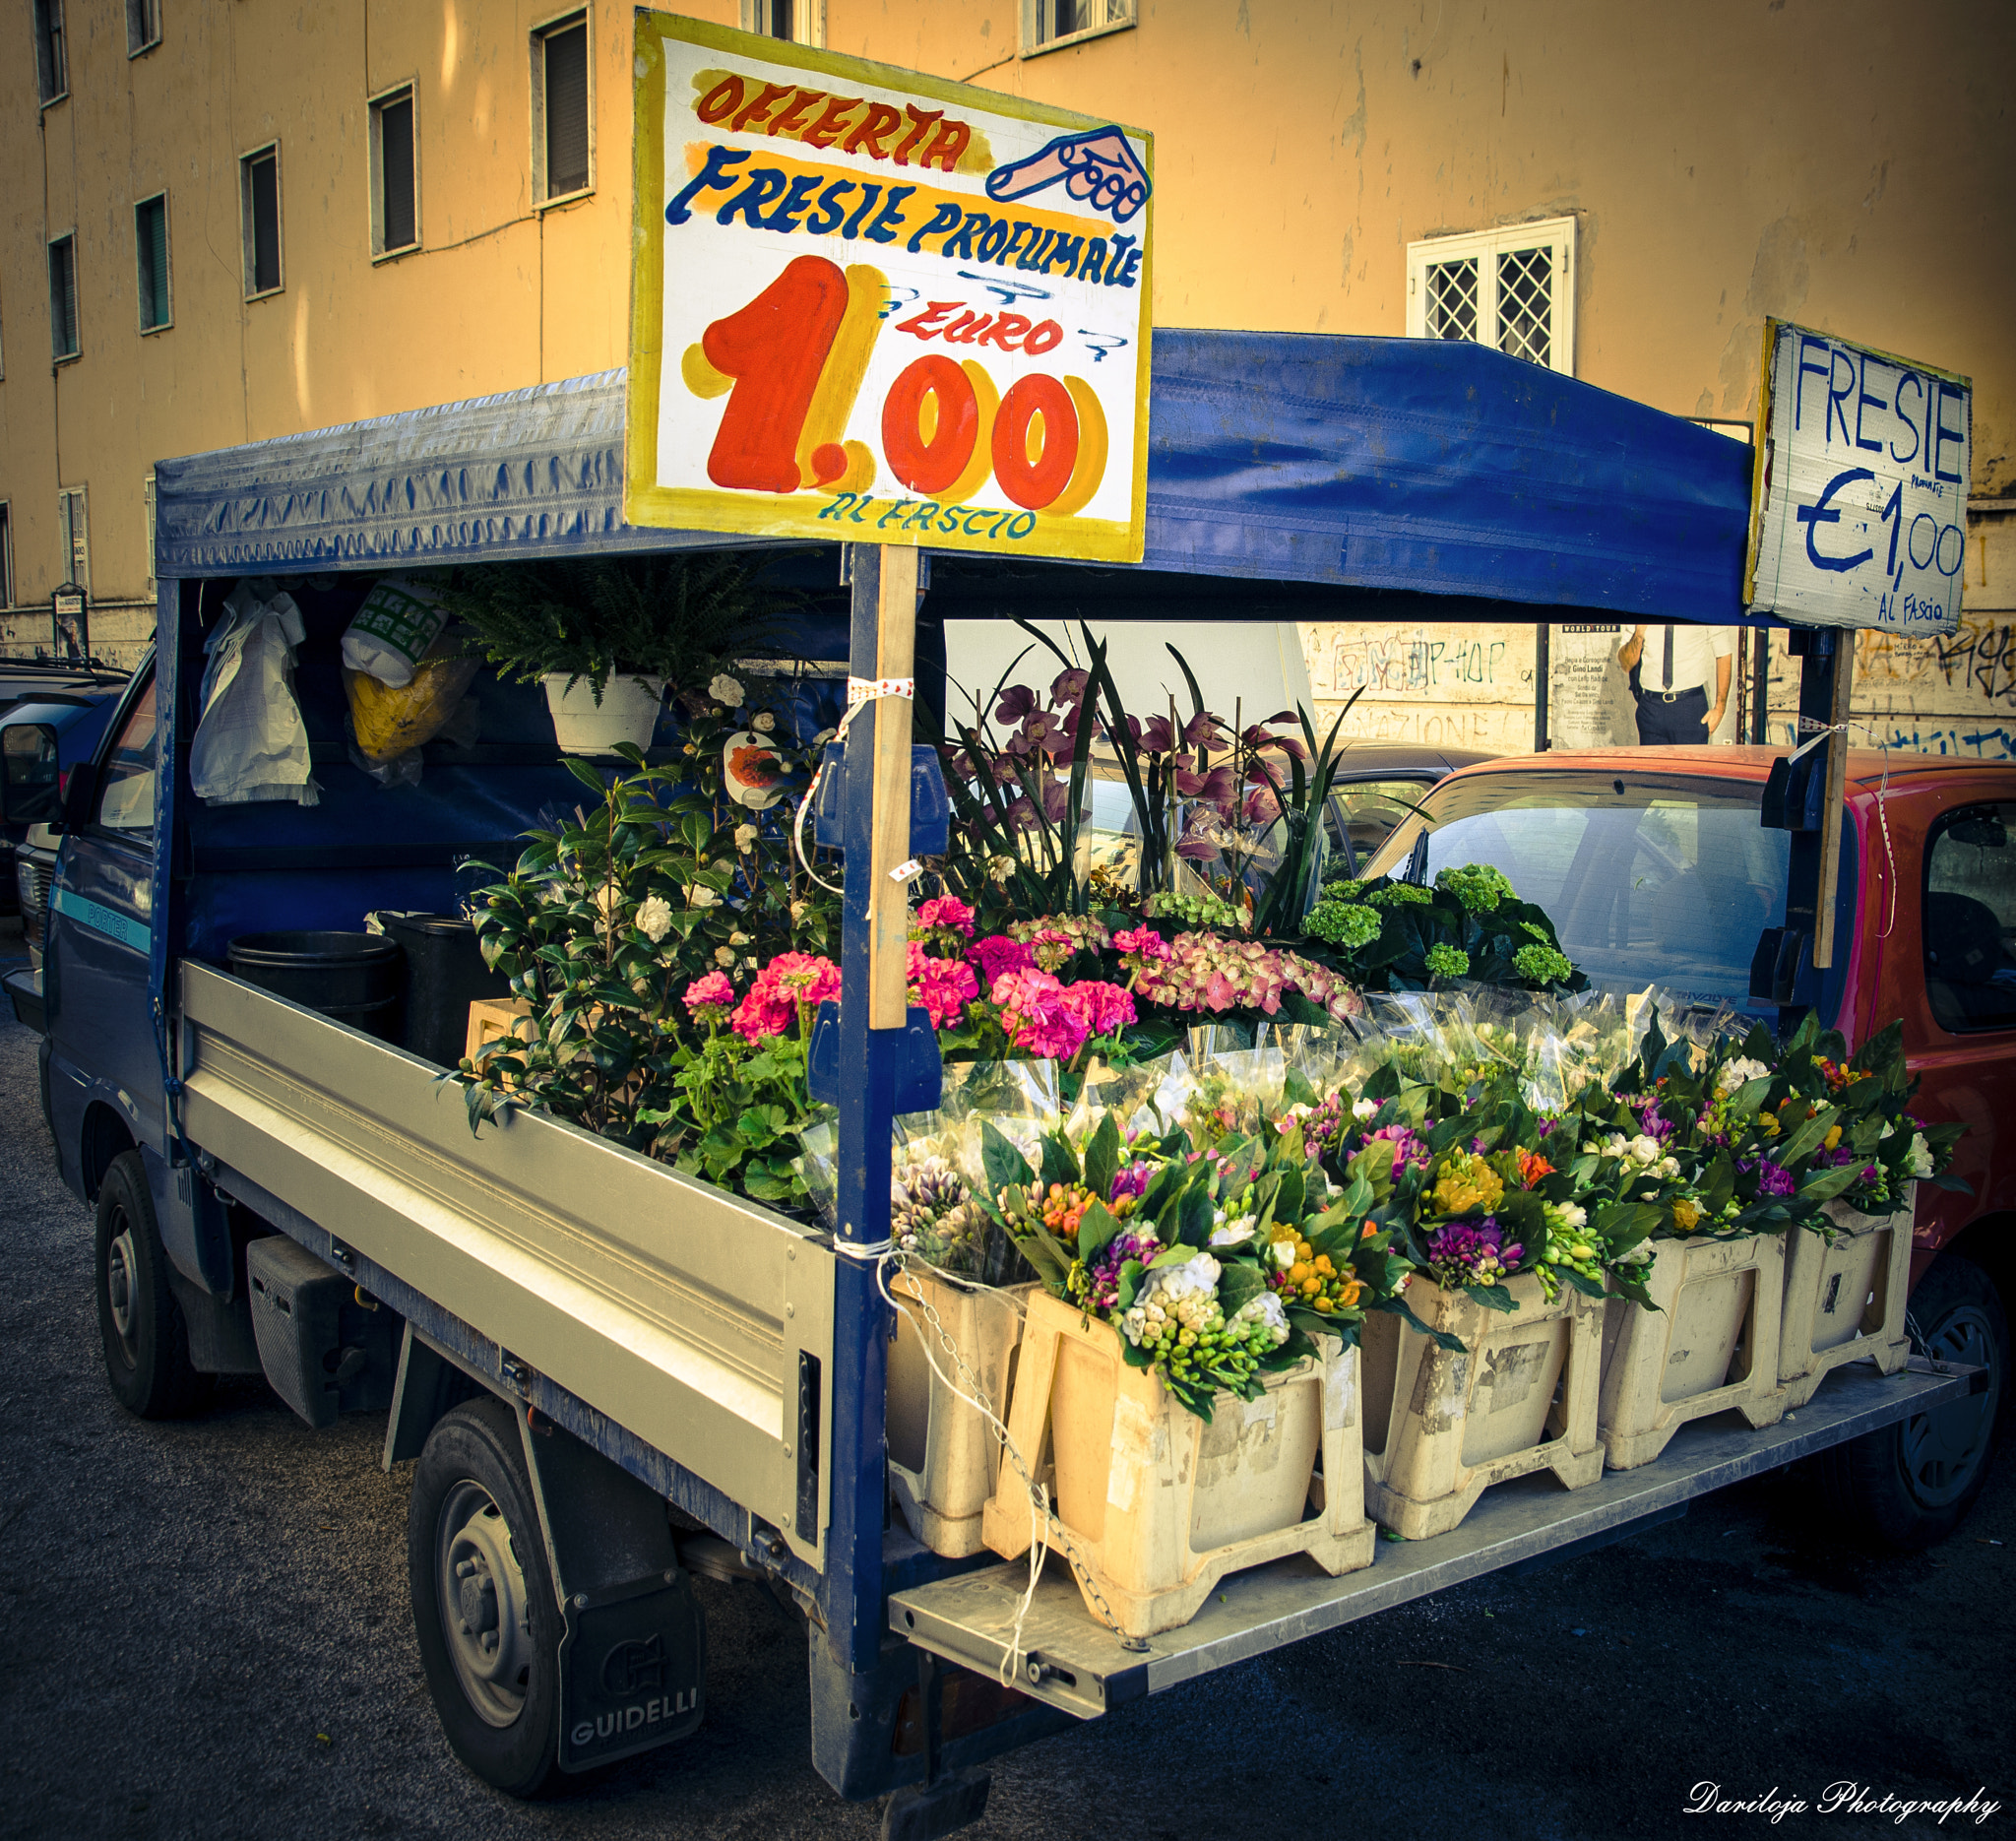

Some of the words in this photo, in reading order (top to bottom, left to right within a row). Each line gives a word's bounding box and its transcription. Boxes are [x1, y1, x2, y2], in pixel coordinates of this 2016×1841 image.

[696, 75, 971, 172] OFFERTA
[664, 144, 916, 243] FRESIE
[908, 202, 1143, 287] PROFUMATE
[895, 301, 1064, 354] EURO
[702, 254, 1079, 511] 1.00
[1796, 336, 1965, 484] FRESIE
[817, 491, 866, 522] AL
[878, 500, 1037, 540] FASCIO
[1796, 468, 1965, 593] €1,00
[1878, 592, 1896, 621] AL
[87, 904, 128, 941] PORTER
[571, 1687, 697, 1746] GUIDELLI
